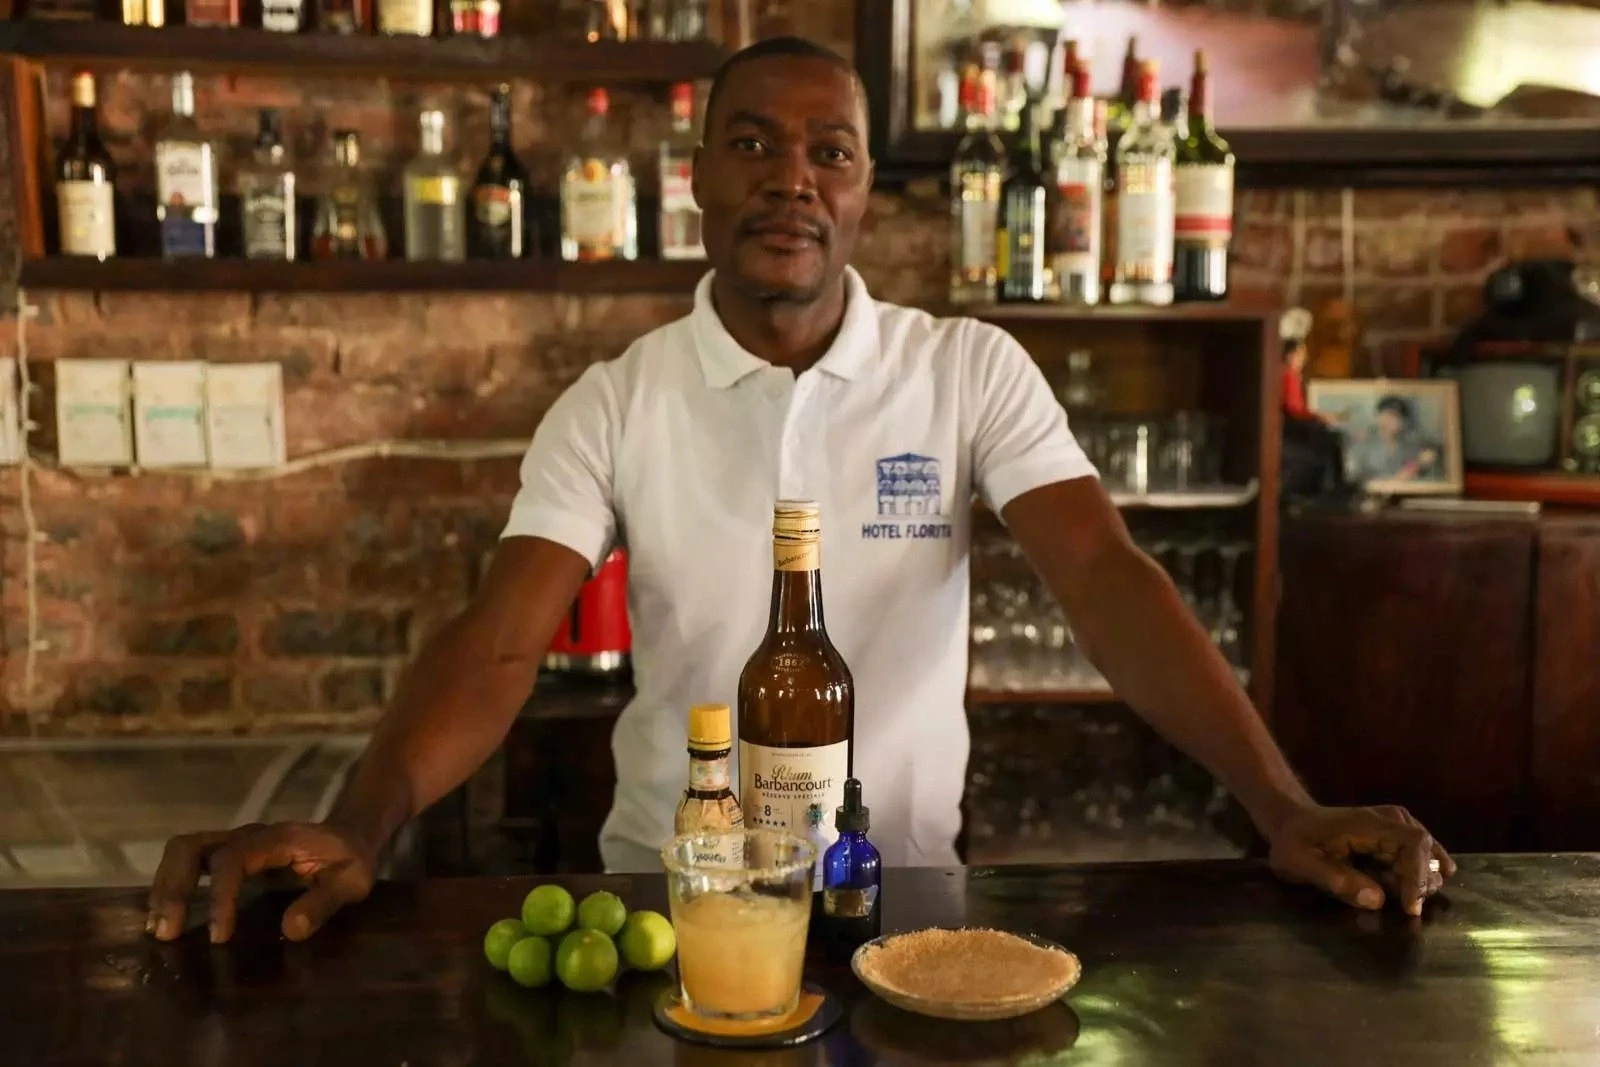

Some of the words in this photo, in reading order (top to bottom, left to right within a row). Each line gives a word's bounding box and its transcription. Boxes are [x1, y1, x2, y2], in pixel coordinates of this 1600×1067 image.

[862, 523, 901, 539] HOTEL
[770, 763, 813, 780] Rhum
[754, 773, 831, 792] Barbancourt
[764, 804, 772, 817] 8
